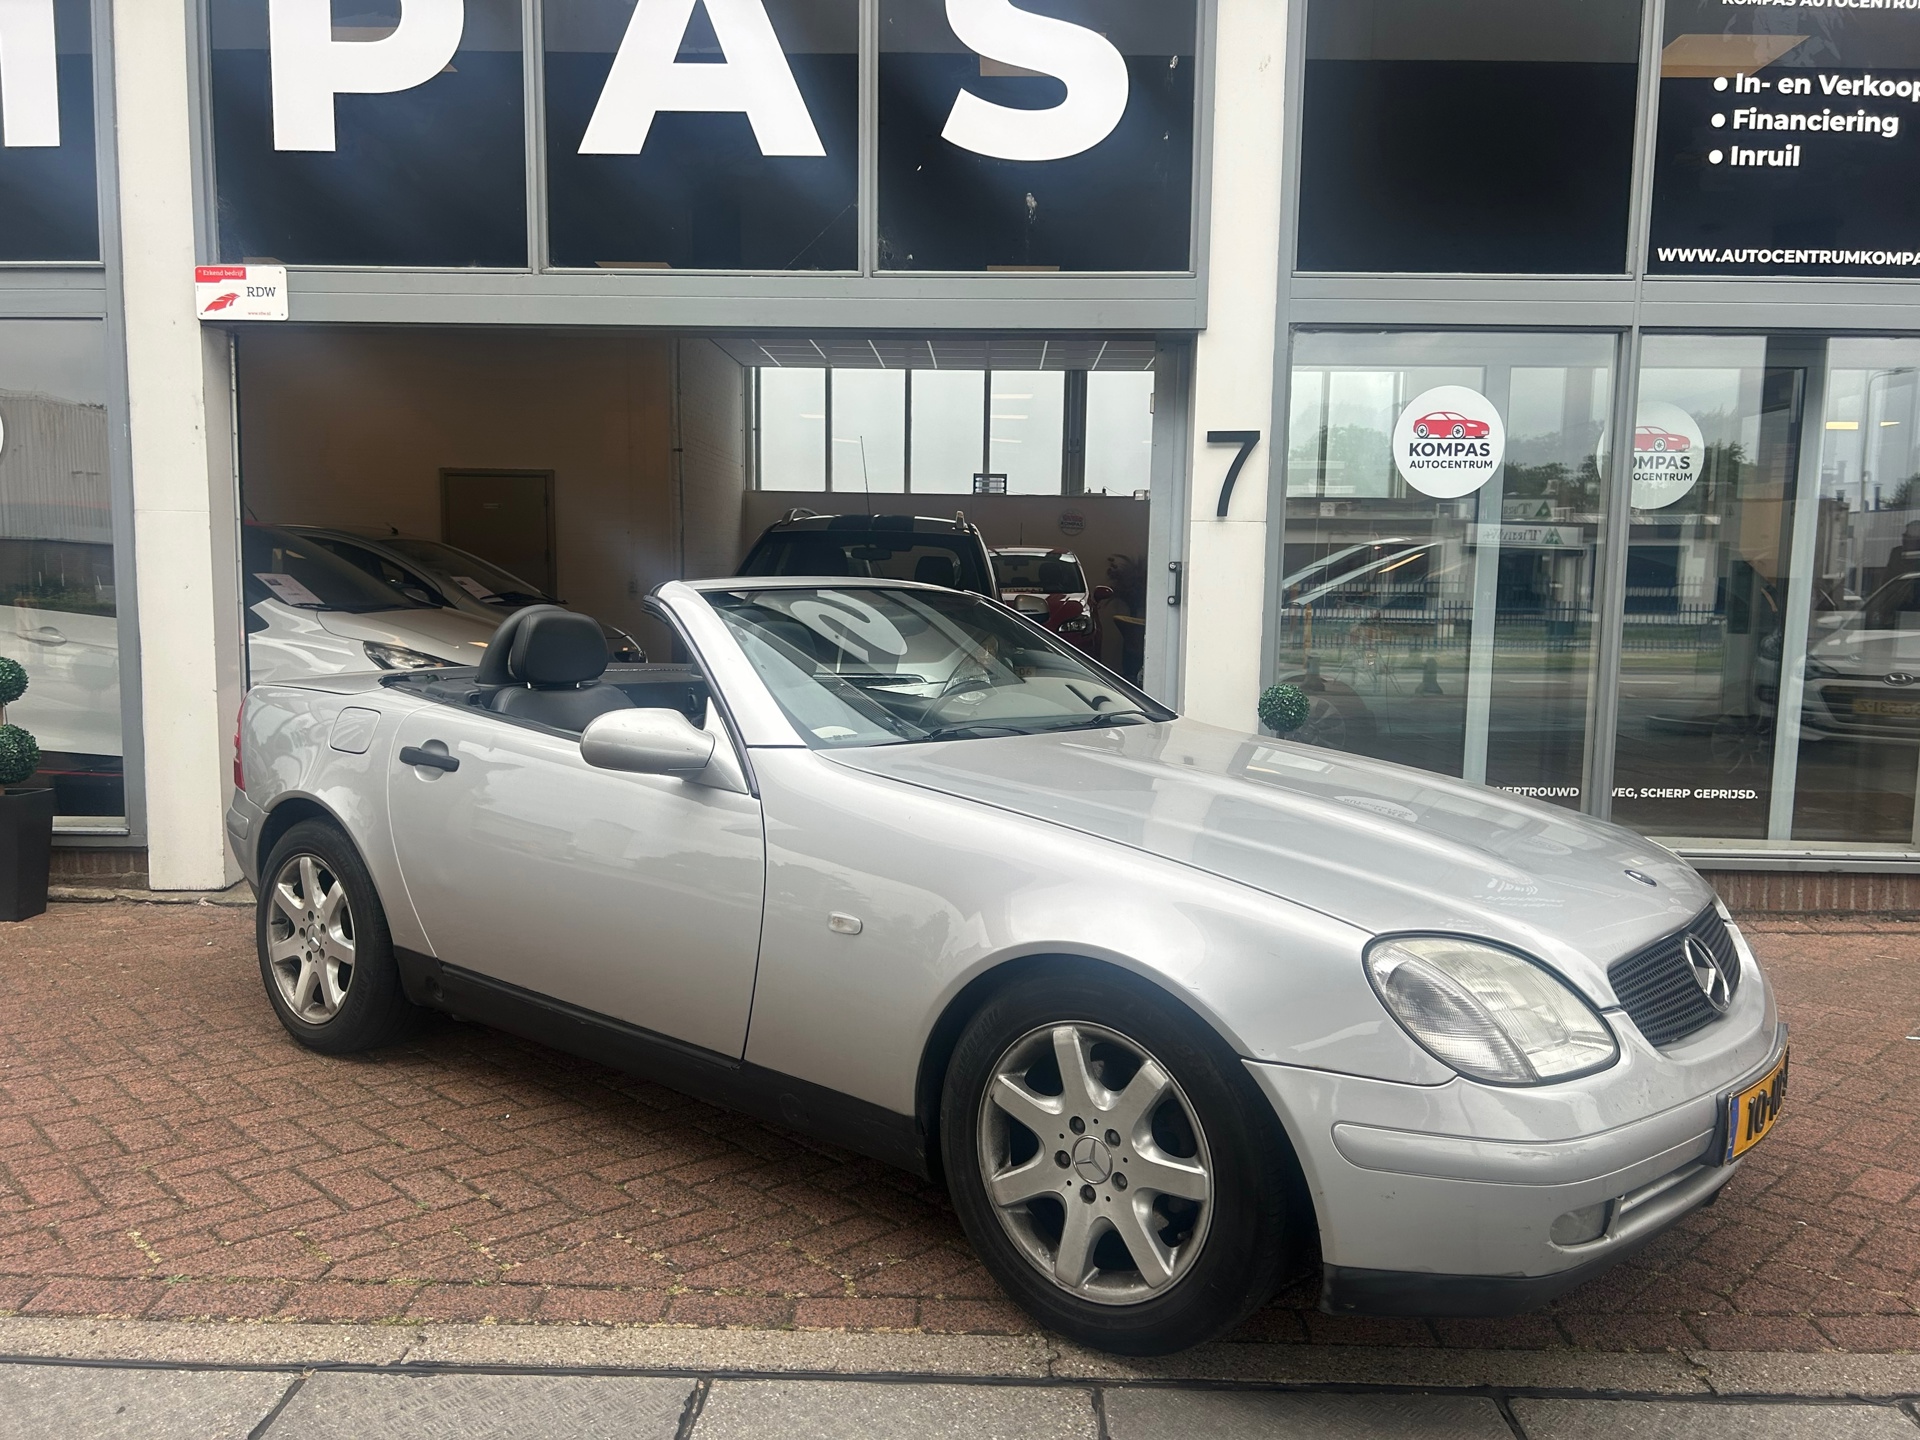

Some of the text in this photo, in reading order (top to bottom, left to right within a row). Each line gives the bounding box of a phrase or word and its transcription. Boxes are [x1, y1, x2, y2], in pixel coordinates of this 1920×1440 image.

[0, 0, 1129, 161] PAS
[1735, 73, 1771, 93] In-
[1777, 78, 1811, 95] en
[1733, 107, 1899, 138] Financiering
[1730, 144, 1801, 167] Inruil
[246, 286, 276, 298] RDW
[1409, 442, 1490, 457] KOMPAS
[1409, 460, 1493, 469] AUTOCENTRUM
[1633, 455, 1690, 470] MPAS
[1207, 430, 1260, 517] 7
[1633, 472, 1693, 481] OCENTRUM
[1640, 788, 1691, 798] SCHERP
[1694, 789, 1758, 799] GEPRIJSD.
